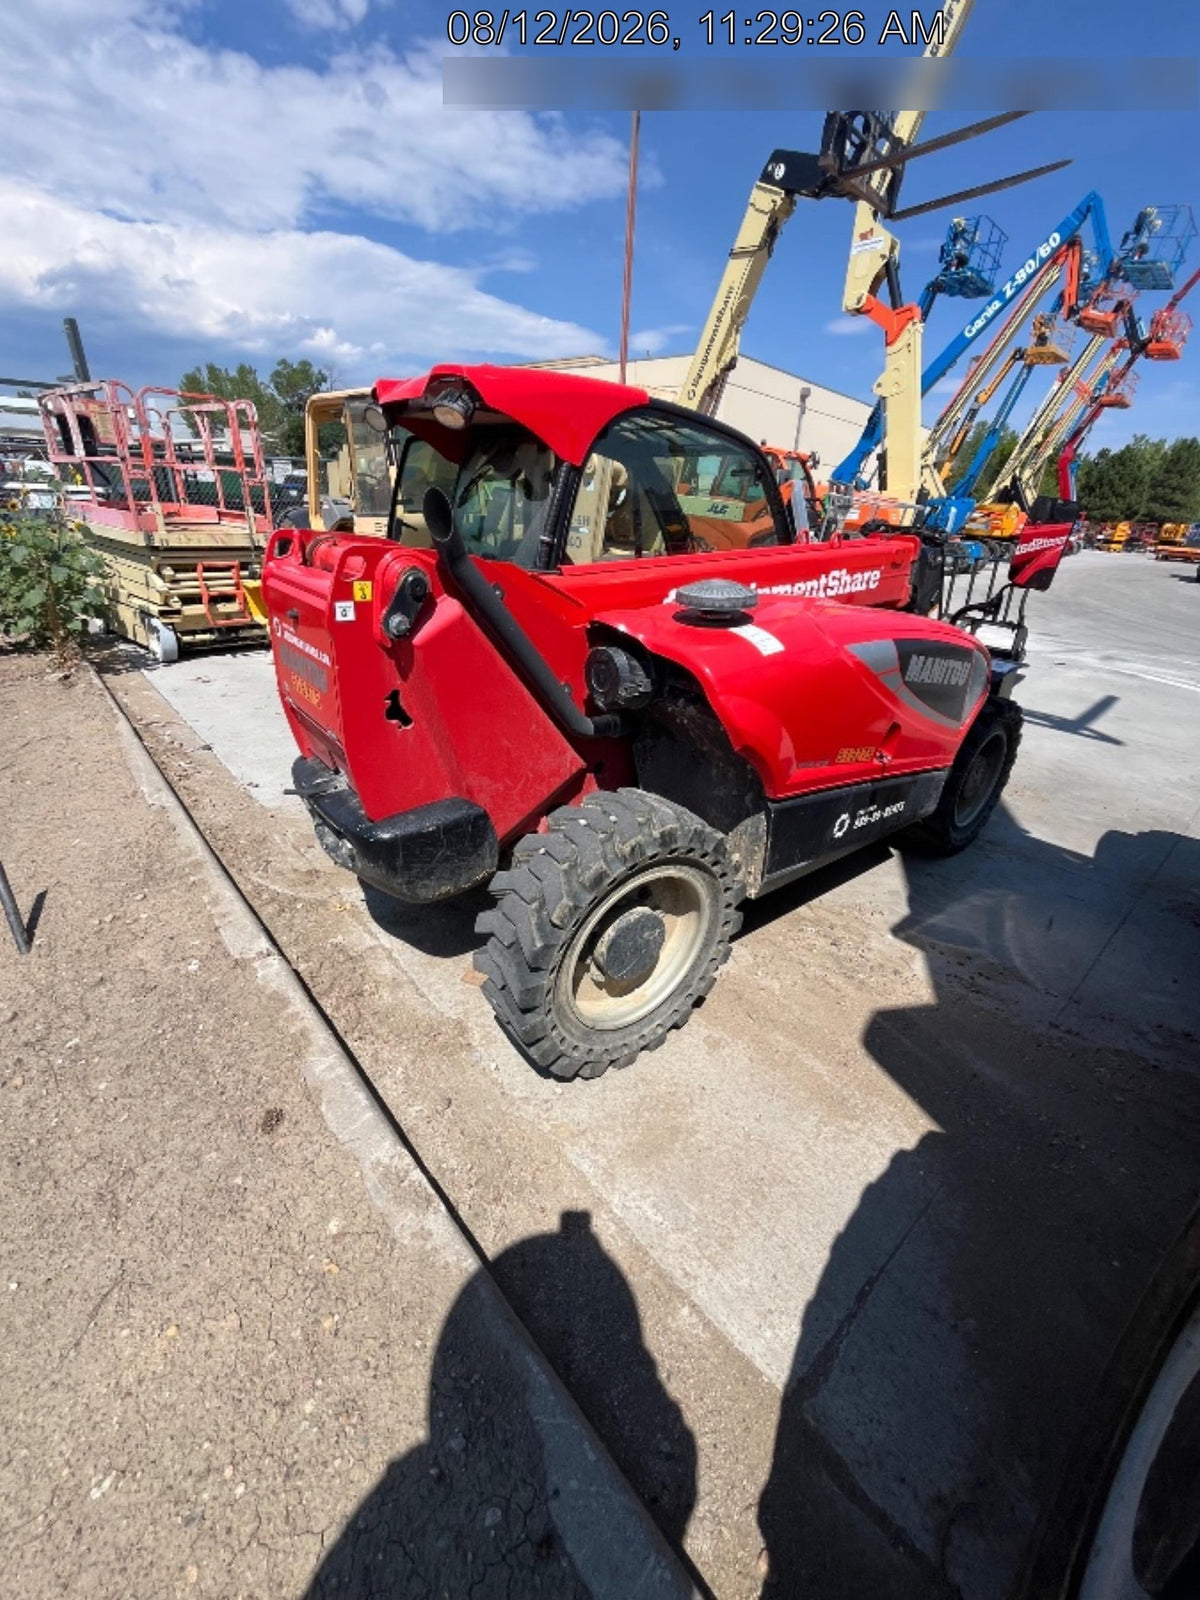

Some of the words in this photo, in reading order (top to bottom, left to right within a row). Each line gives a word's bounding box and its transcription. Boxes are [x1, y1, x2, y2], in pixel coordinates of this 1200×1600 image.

[964, 299, 1003, 338] Genie
[1002, 232, 1061, 299] Z-80/60
[904, 653, 972, 687] MANITOU
